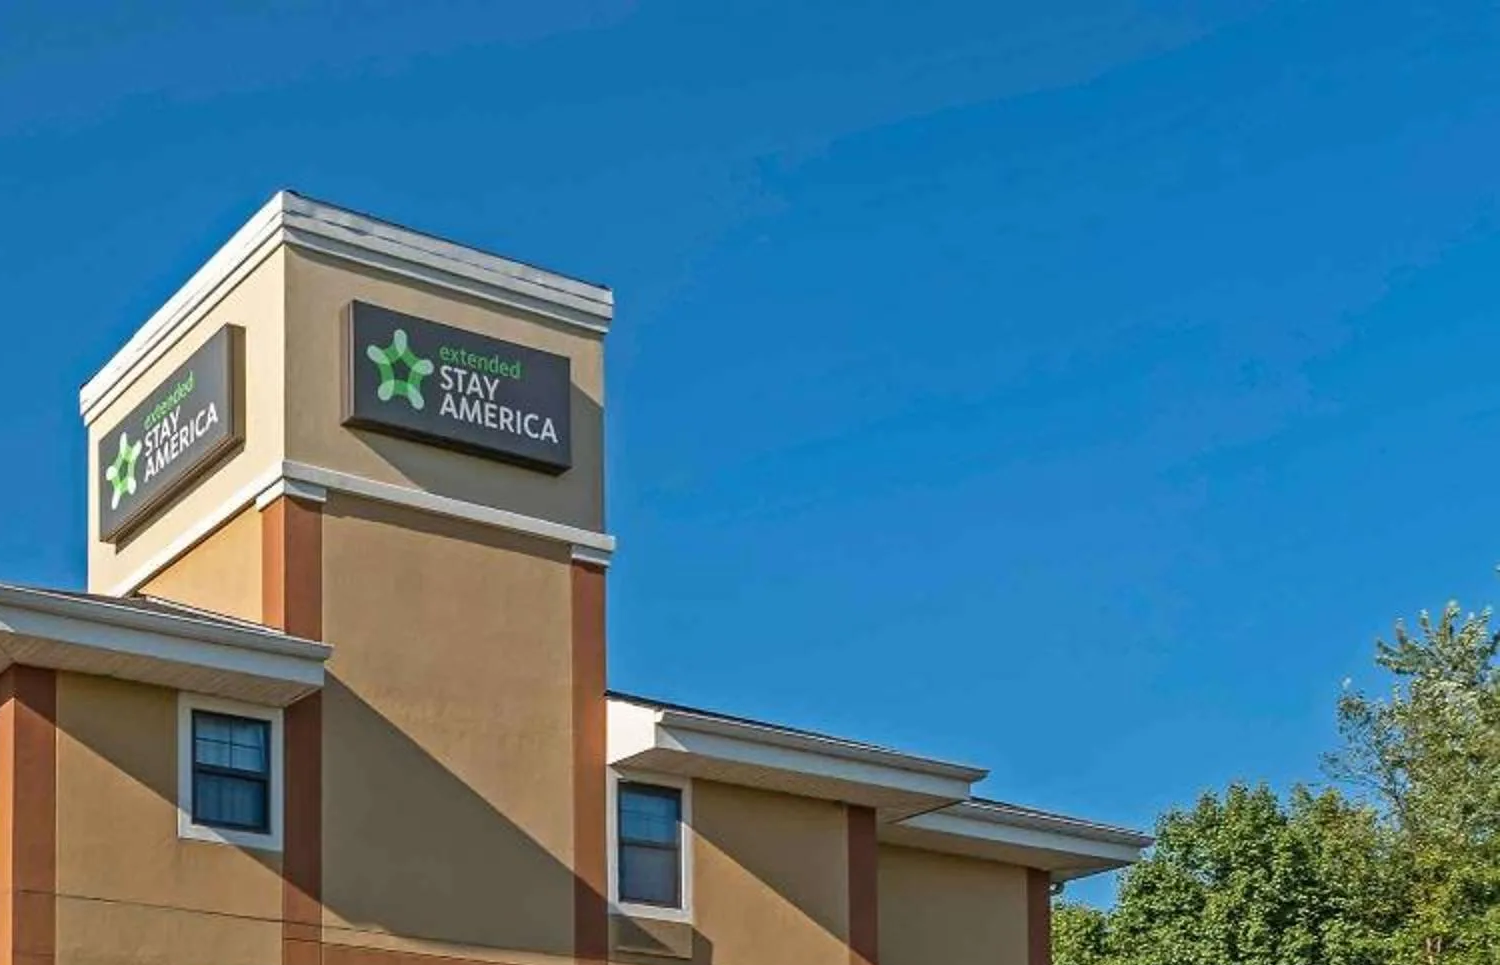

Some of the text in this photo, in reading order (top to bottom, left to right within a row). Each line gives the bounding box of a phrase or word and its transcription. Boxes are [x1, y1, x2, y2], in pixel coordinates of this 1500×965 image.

[440, 346, 521, 379] extended
[441, 366, 499, 401] STAY
[143, 372, 194, 429] extended
[440, 392, 558, 443] AMERICA
[145, 406, 180, 456] STAY
[145, 403, 218, 482] AMERICA
